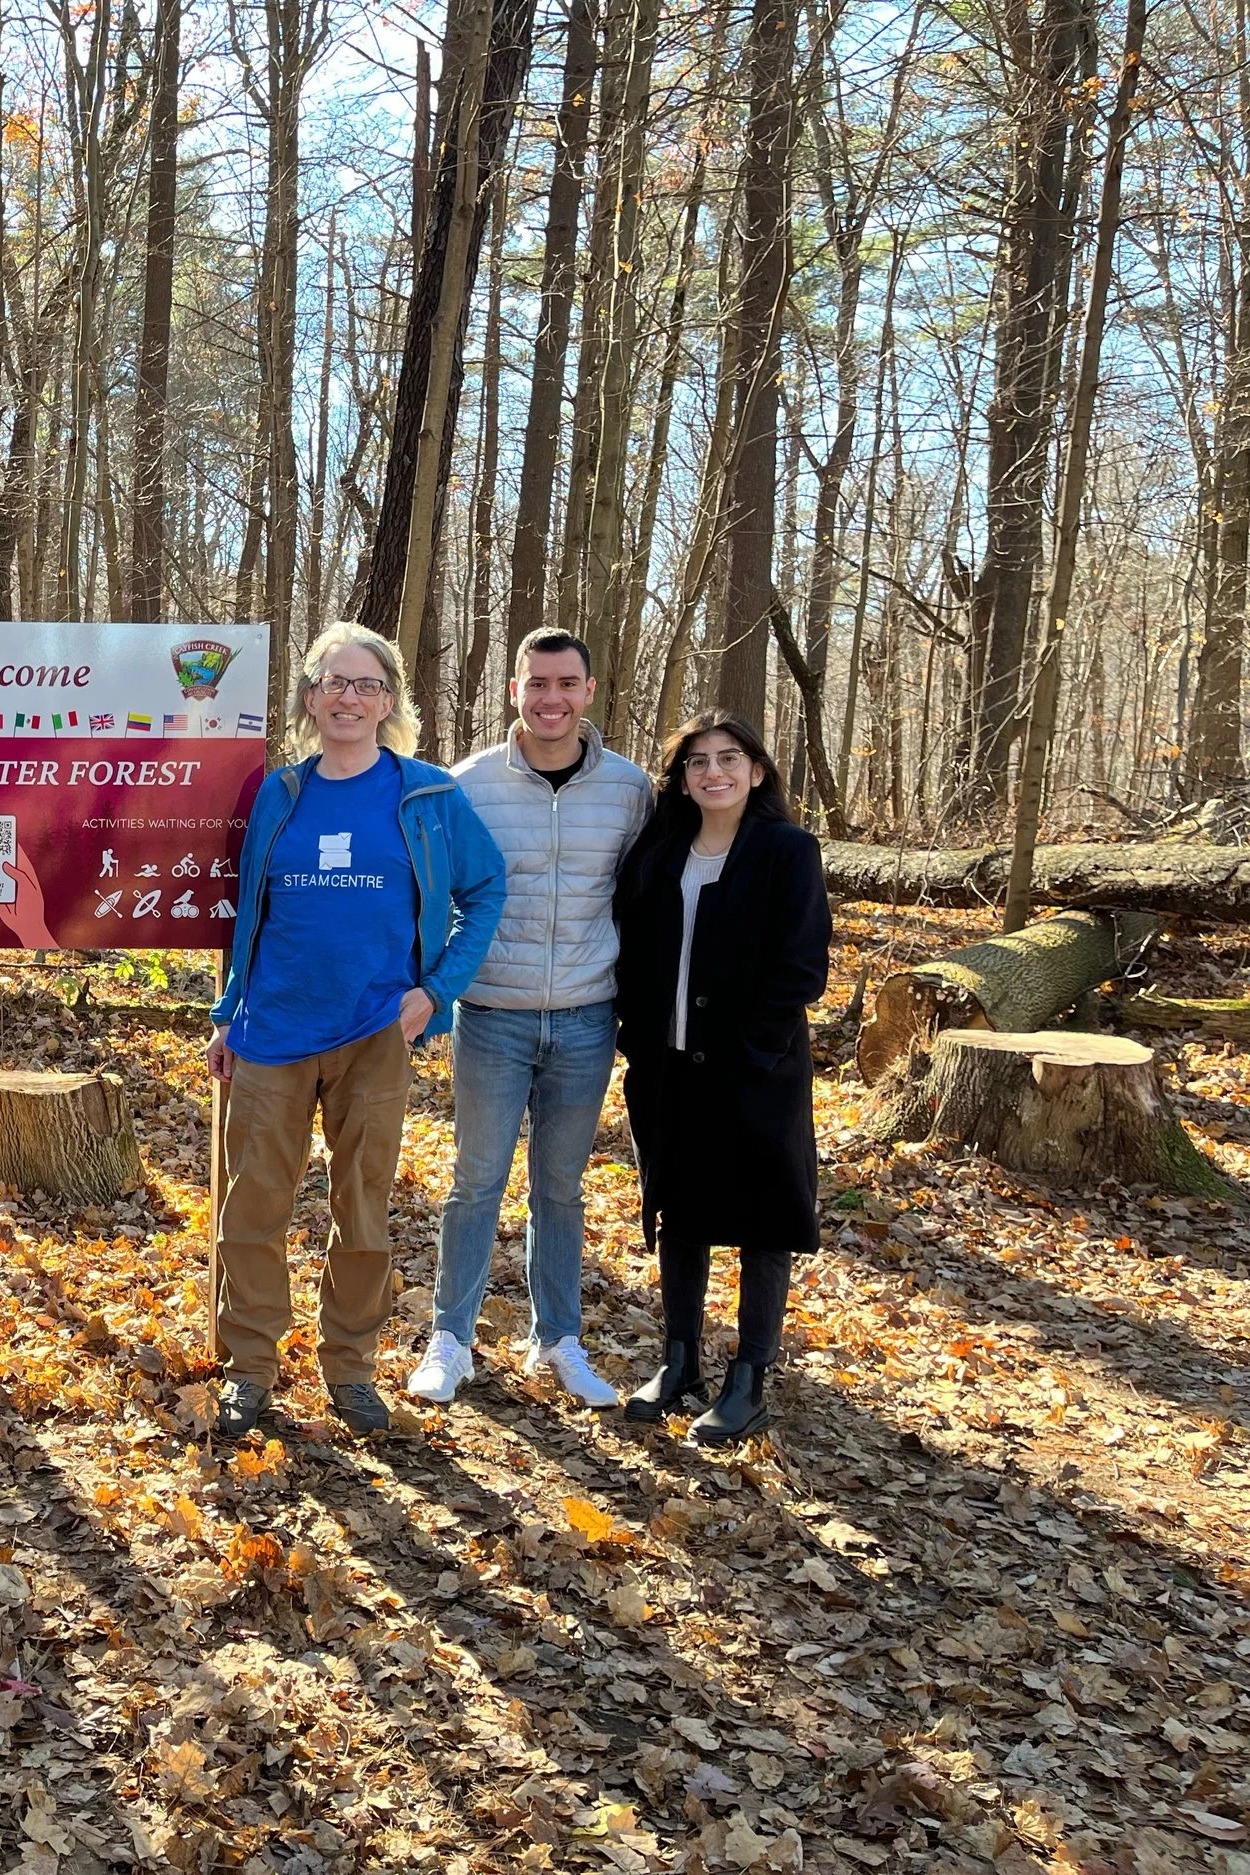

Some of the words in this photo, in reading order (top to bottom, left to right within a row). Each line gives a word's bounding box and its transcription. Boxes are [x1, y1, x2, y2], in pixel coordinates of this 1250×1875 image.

[205, 643, 227, 655] CREEK
[67, 760, 201, 786] FOREST
[82, 818, 145, 829] ACTIVITIES
[148, 818, 196, 829] WAITING
[199, 818, 223, 829] FOR
[284, 874, 385, 889] STEAMCENTRE
